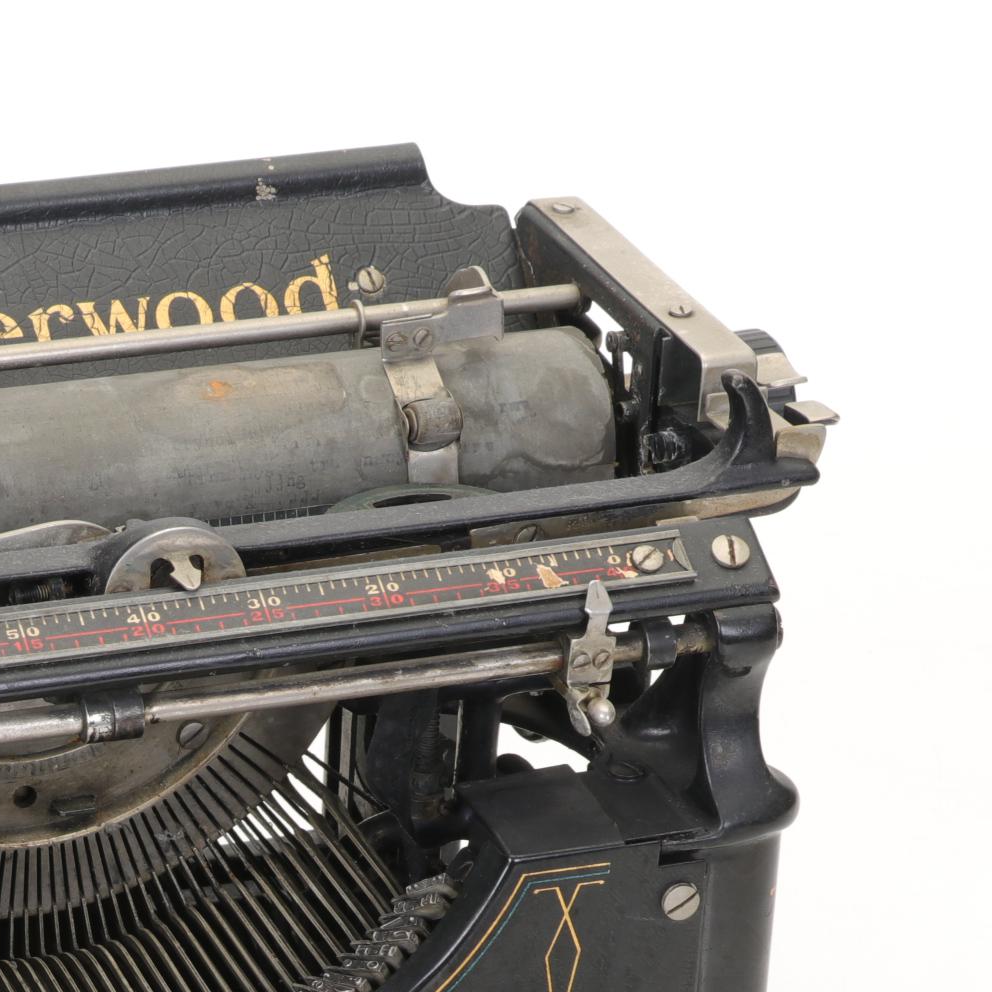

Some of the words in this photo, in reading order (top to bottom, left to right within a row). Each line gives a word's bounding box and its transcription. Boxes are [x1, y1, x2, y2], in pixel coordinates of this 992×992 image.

[6, 627, 40, 640] 50
[127, 611, 161, 624] 40
[247, 596, 282, 609] 30
[365, 582, 400, 595] 20
